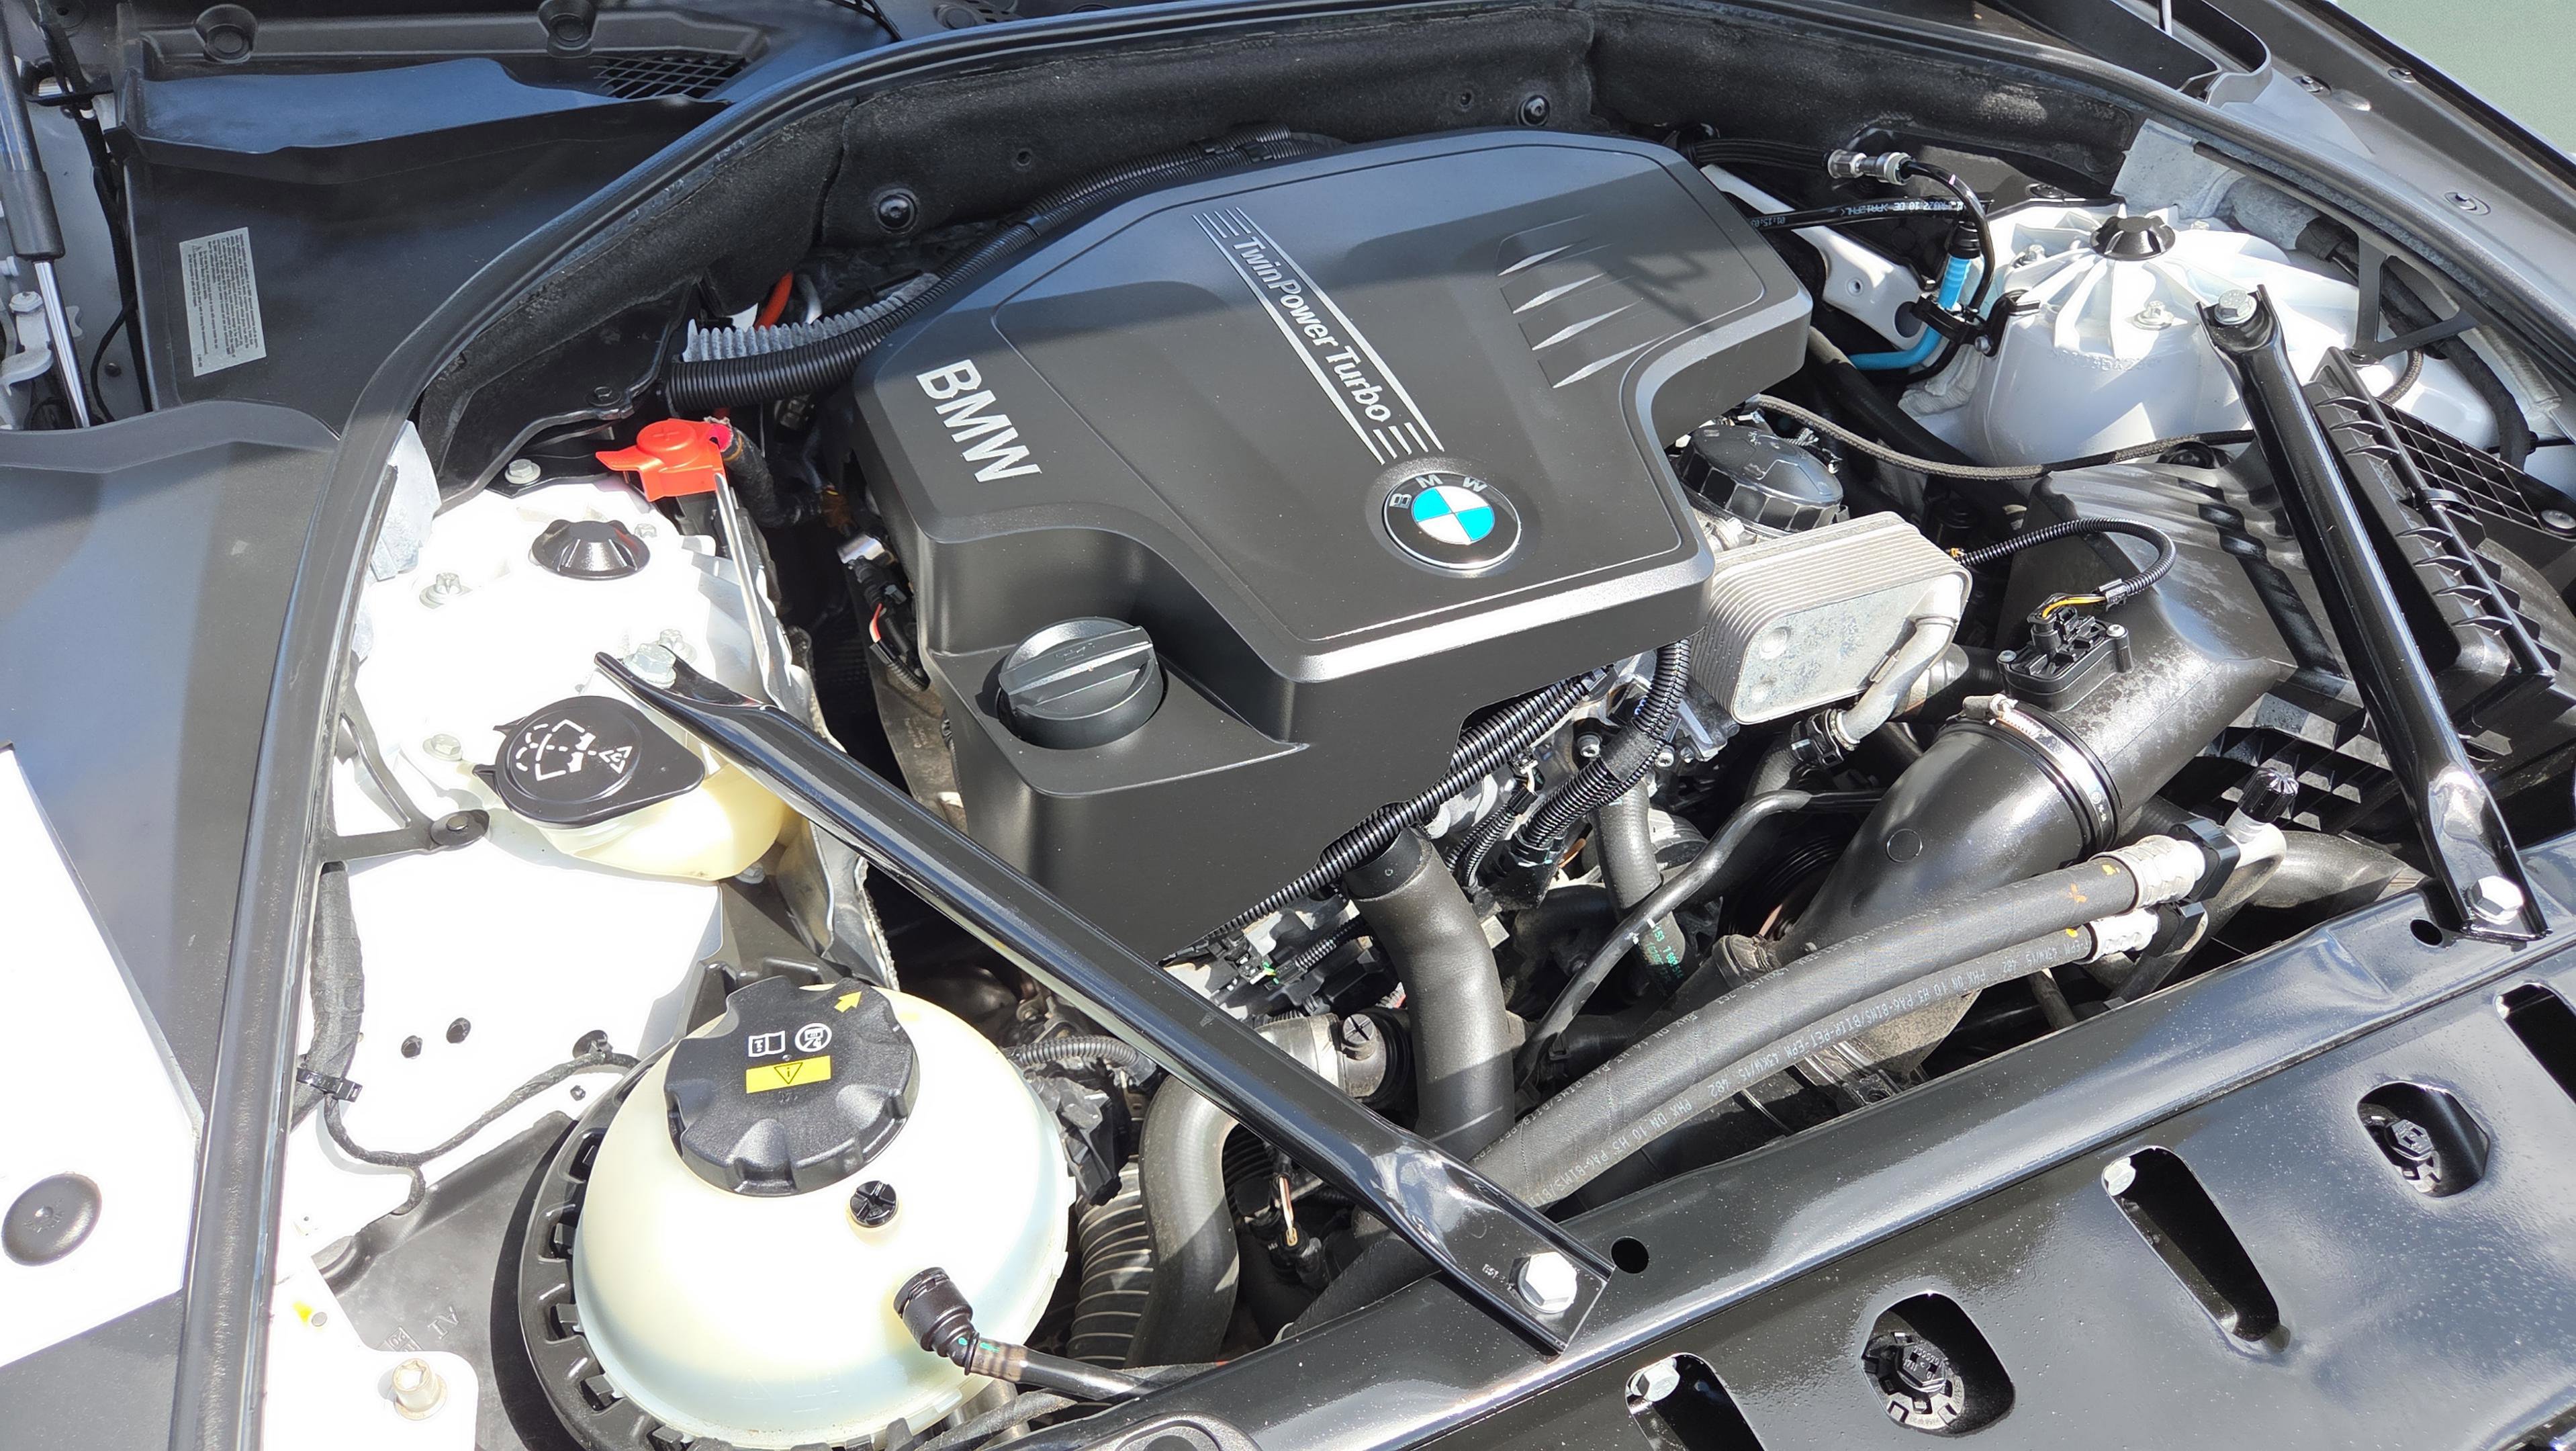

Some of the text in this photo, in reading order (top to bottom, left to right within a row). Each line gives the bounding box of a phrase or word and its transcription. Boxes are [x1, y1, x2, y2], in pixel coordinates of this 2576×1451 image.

[1232, 236, 1392, 423] TwinPower Turbo
[916, 359, 1042, 483] BMW
[1389, 473, 1488, 511] BMW
[1630, 1123, 1649, 1143] 10
